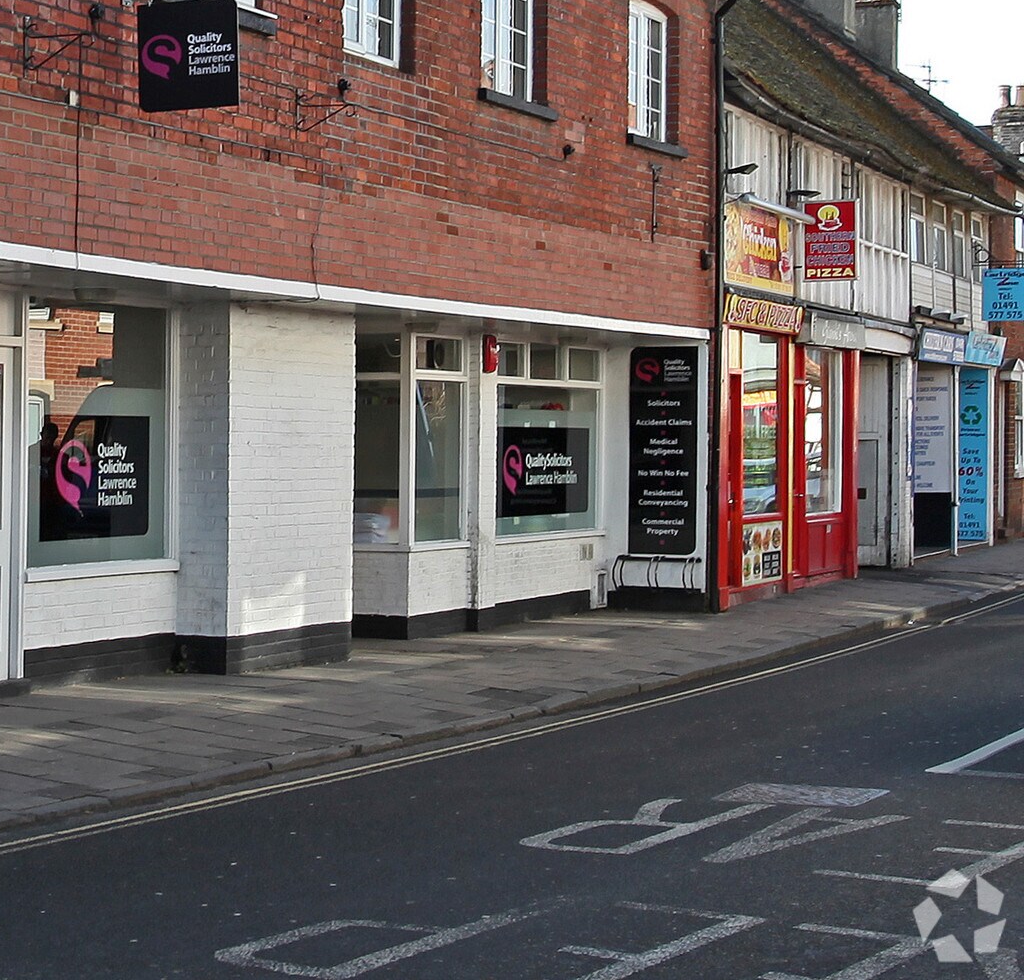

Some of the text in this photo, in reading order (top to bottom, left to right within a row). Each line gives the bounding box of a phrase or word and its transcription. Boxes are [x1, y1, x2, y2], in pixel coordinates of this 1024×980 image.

[187, 32, 223, 45] Quality
[188, 42, 232, 55] Solicitors
[188, 53, 236, 65] Lawrence
[188, 64, 231, 76] Hamblin
[806, 268, 854, 278] PIZZA
[736, 299, 759, 323] SFC
[768, 304, 797, 330] PIZZA
[988, 310, 1023, 319] 577 575
[97, 442, 127, 460] Quality
[643, 448, 684, 456] Negligence
[98, 459, 134, 474] Solicitors
[959, 466, 983, 477] 60%
[98, 476, 136, 490] Lawrence
[525, 470, 578, 485] Lawrence Hamblin
[97, 491, 133, 506] Hamblin
[638, 499, 689, 507] Conveyancing
[646, 528, 679, 536] Property
